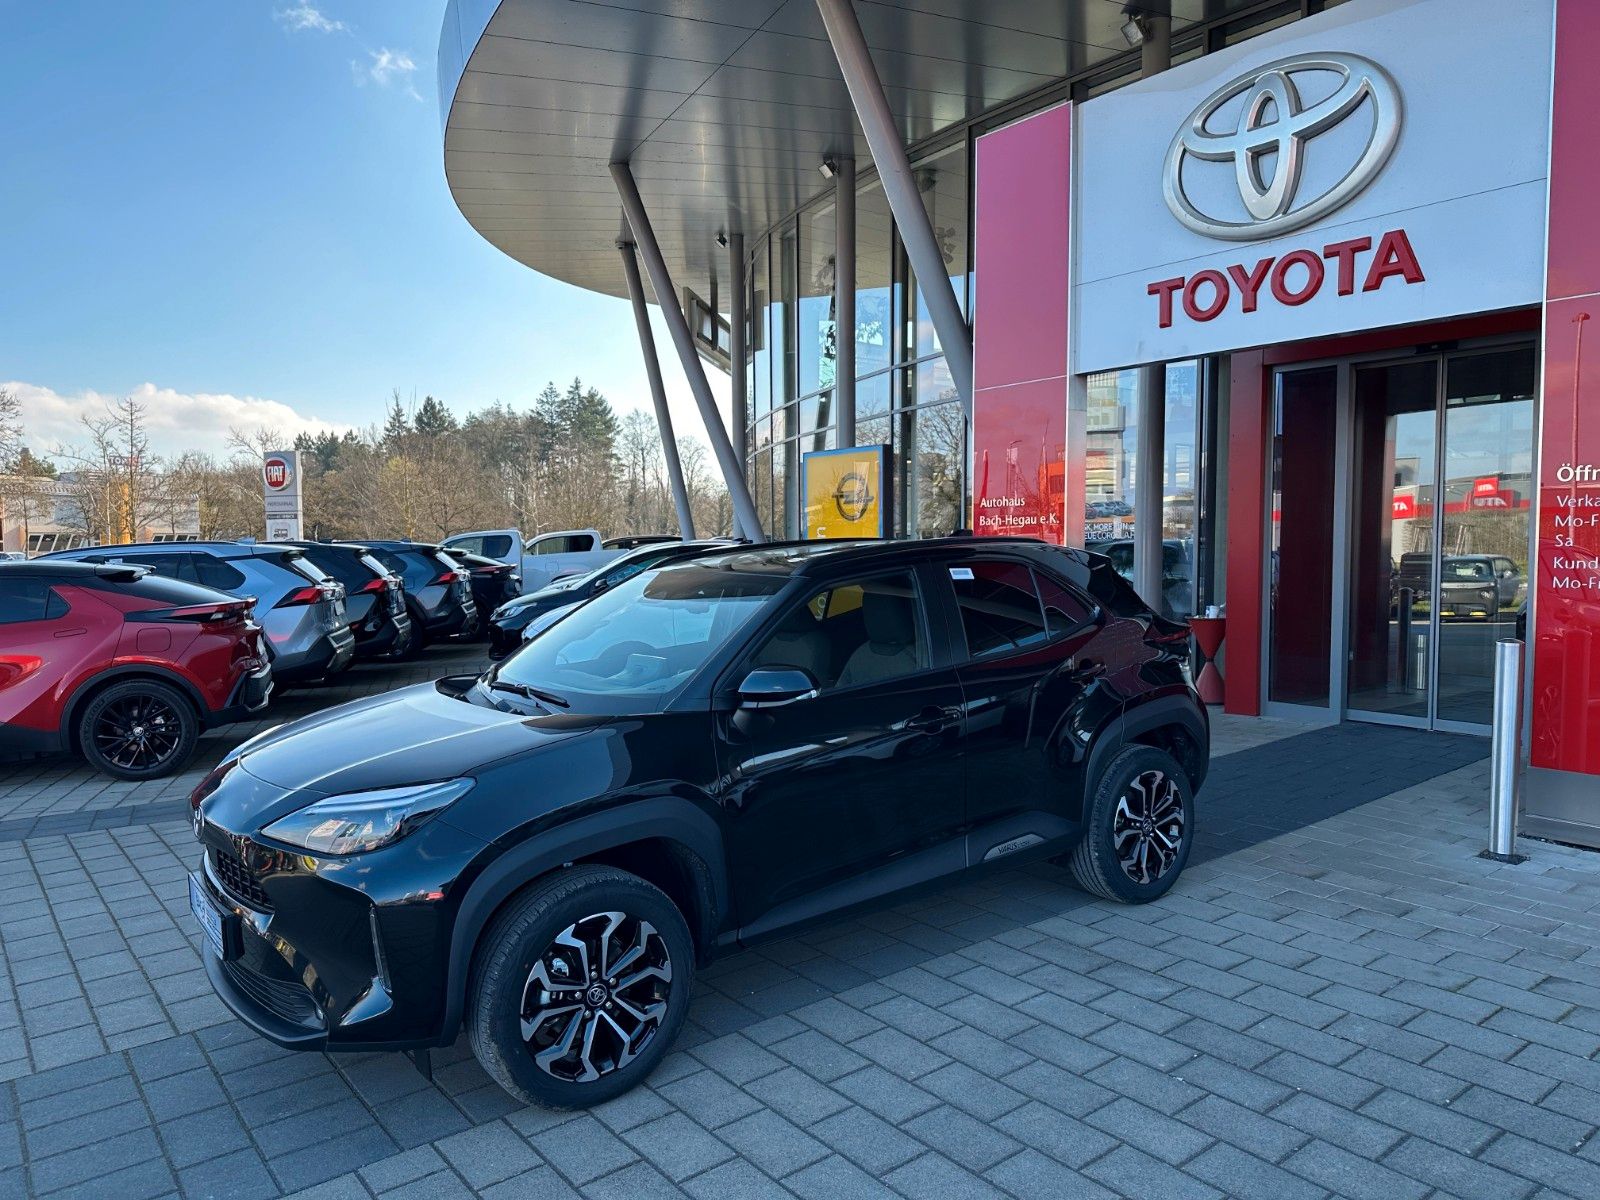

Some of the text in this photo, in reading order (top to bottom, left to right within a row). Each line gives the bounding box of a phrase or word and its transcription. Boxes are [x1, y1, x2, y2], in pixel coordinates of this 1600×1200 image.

[1147, 229, 1425, 328] TOYOTA
[266, 465, 284, 482] FIAT
[980, 495, 1026, 508] Autohaus
[979, 512, 1060, 528] Bach-Hegau e.K.
[1555, 534, 1574, 547] Sa
[1553, 556, 1599, 569] Kund
